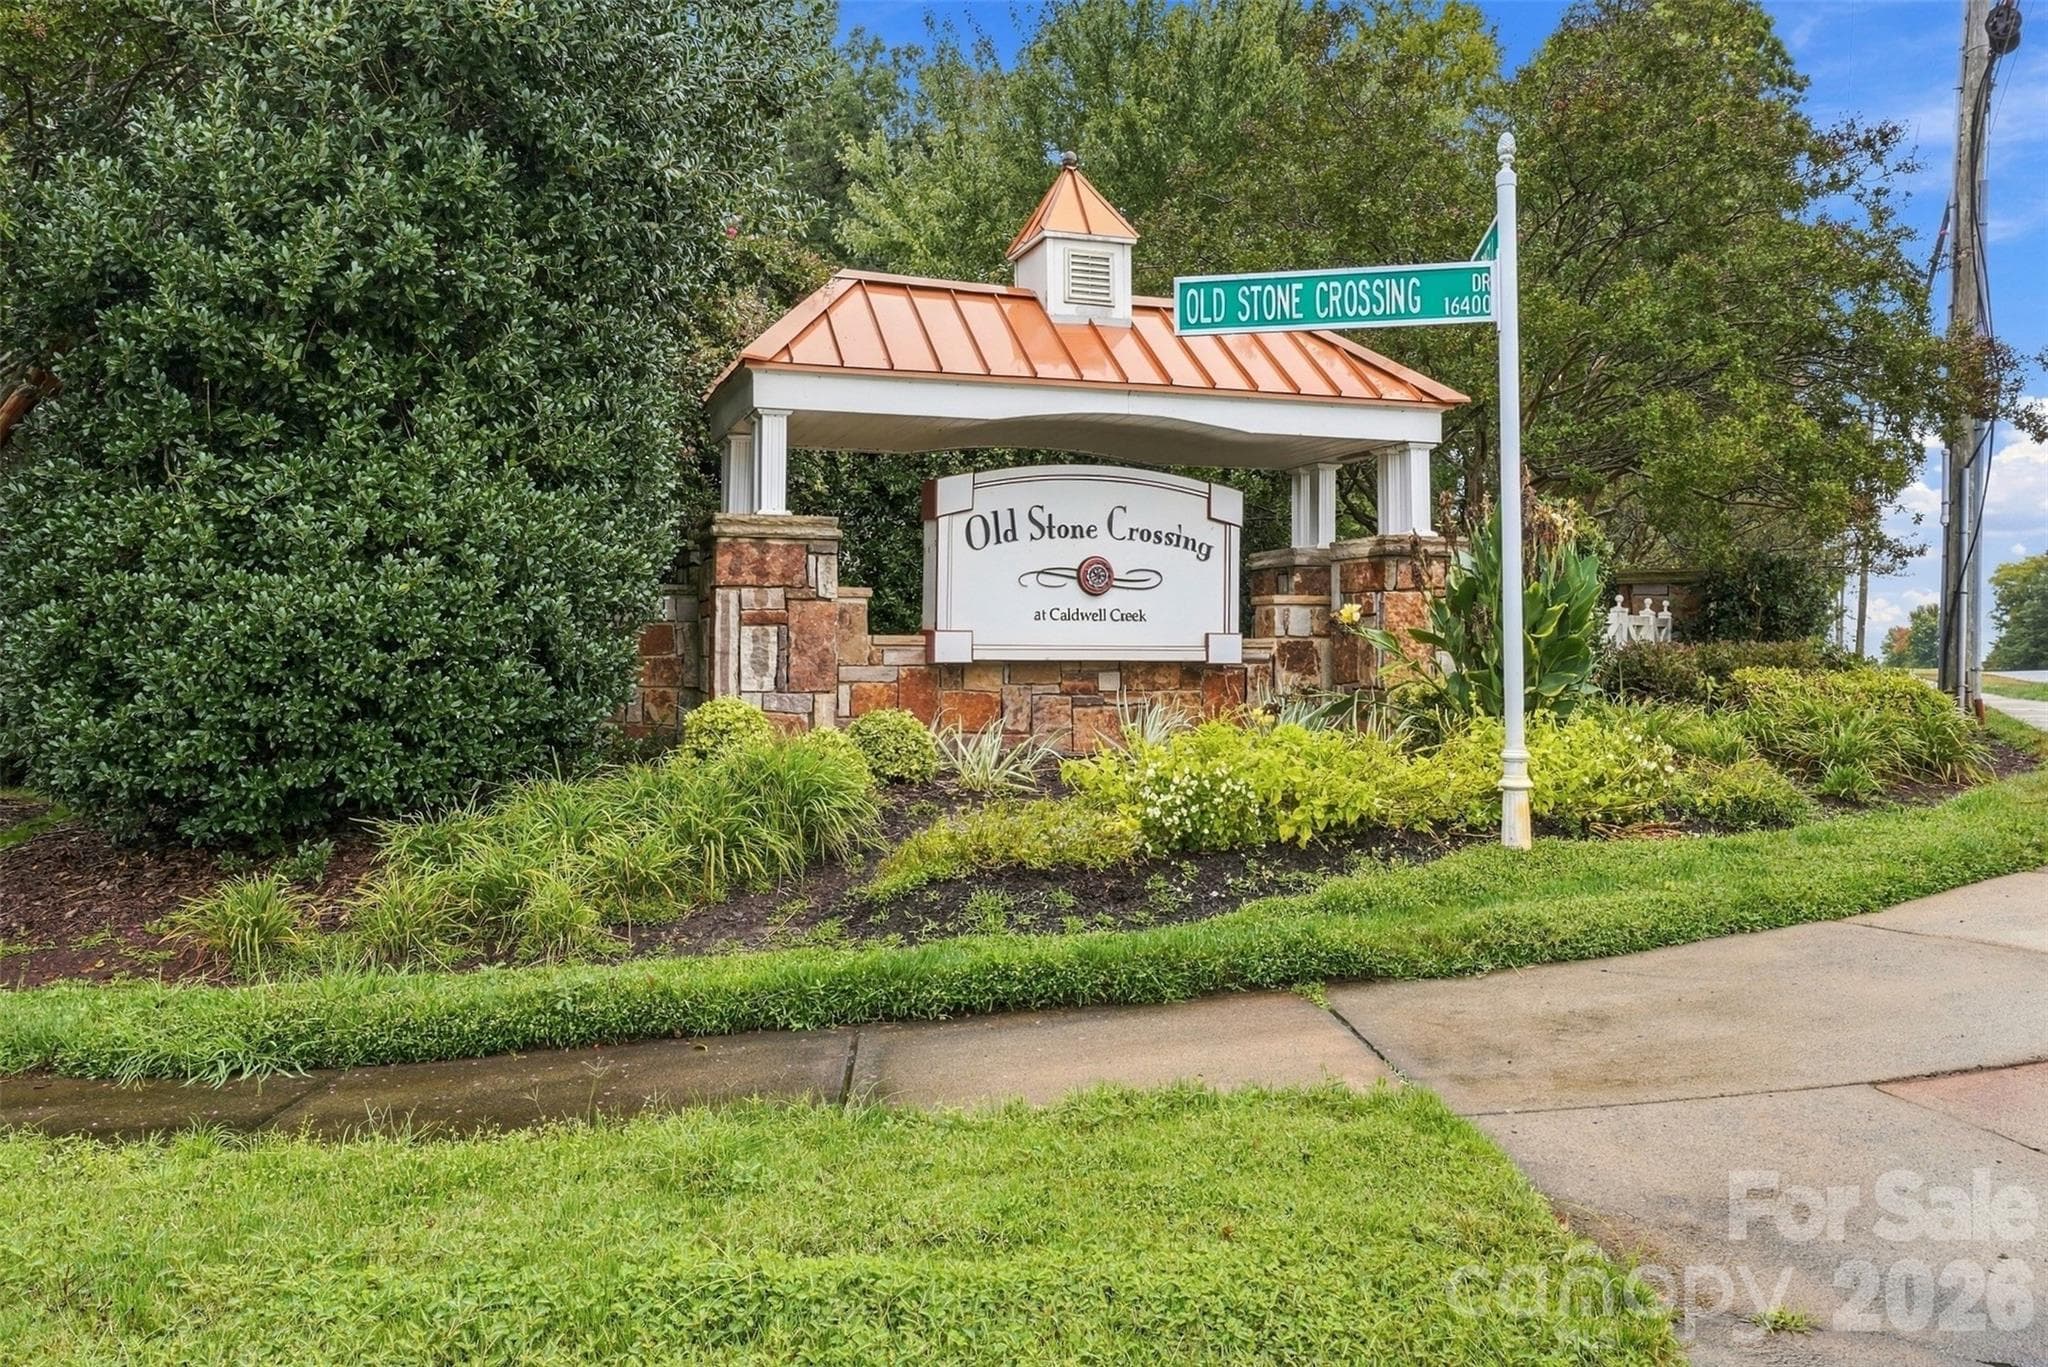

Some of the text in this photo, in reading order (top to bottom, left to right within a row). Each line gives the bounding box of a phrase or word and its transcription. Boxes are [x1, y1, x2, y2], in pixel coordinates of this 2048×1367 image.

[1472, 273, 1490, 292] DR
[1186, 277, 1421, 325] OLD STONE CROSSING
[1444, 294, 1491, 315] 16400
[965, 504, 1215, 562] Old Stone Crossing
[1033, 607, 1148, 623] at Caldwell Creek
